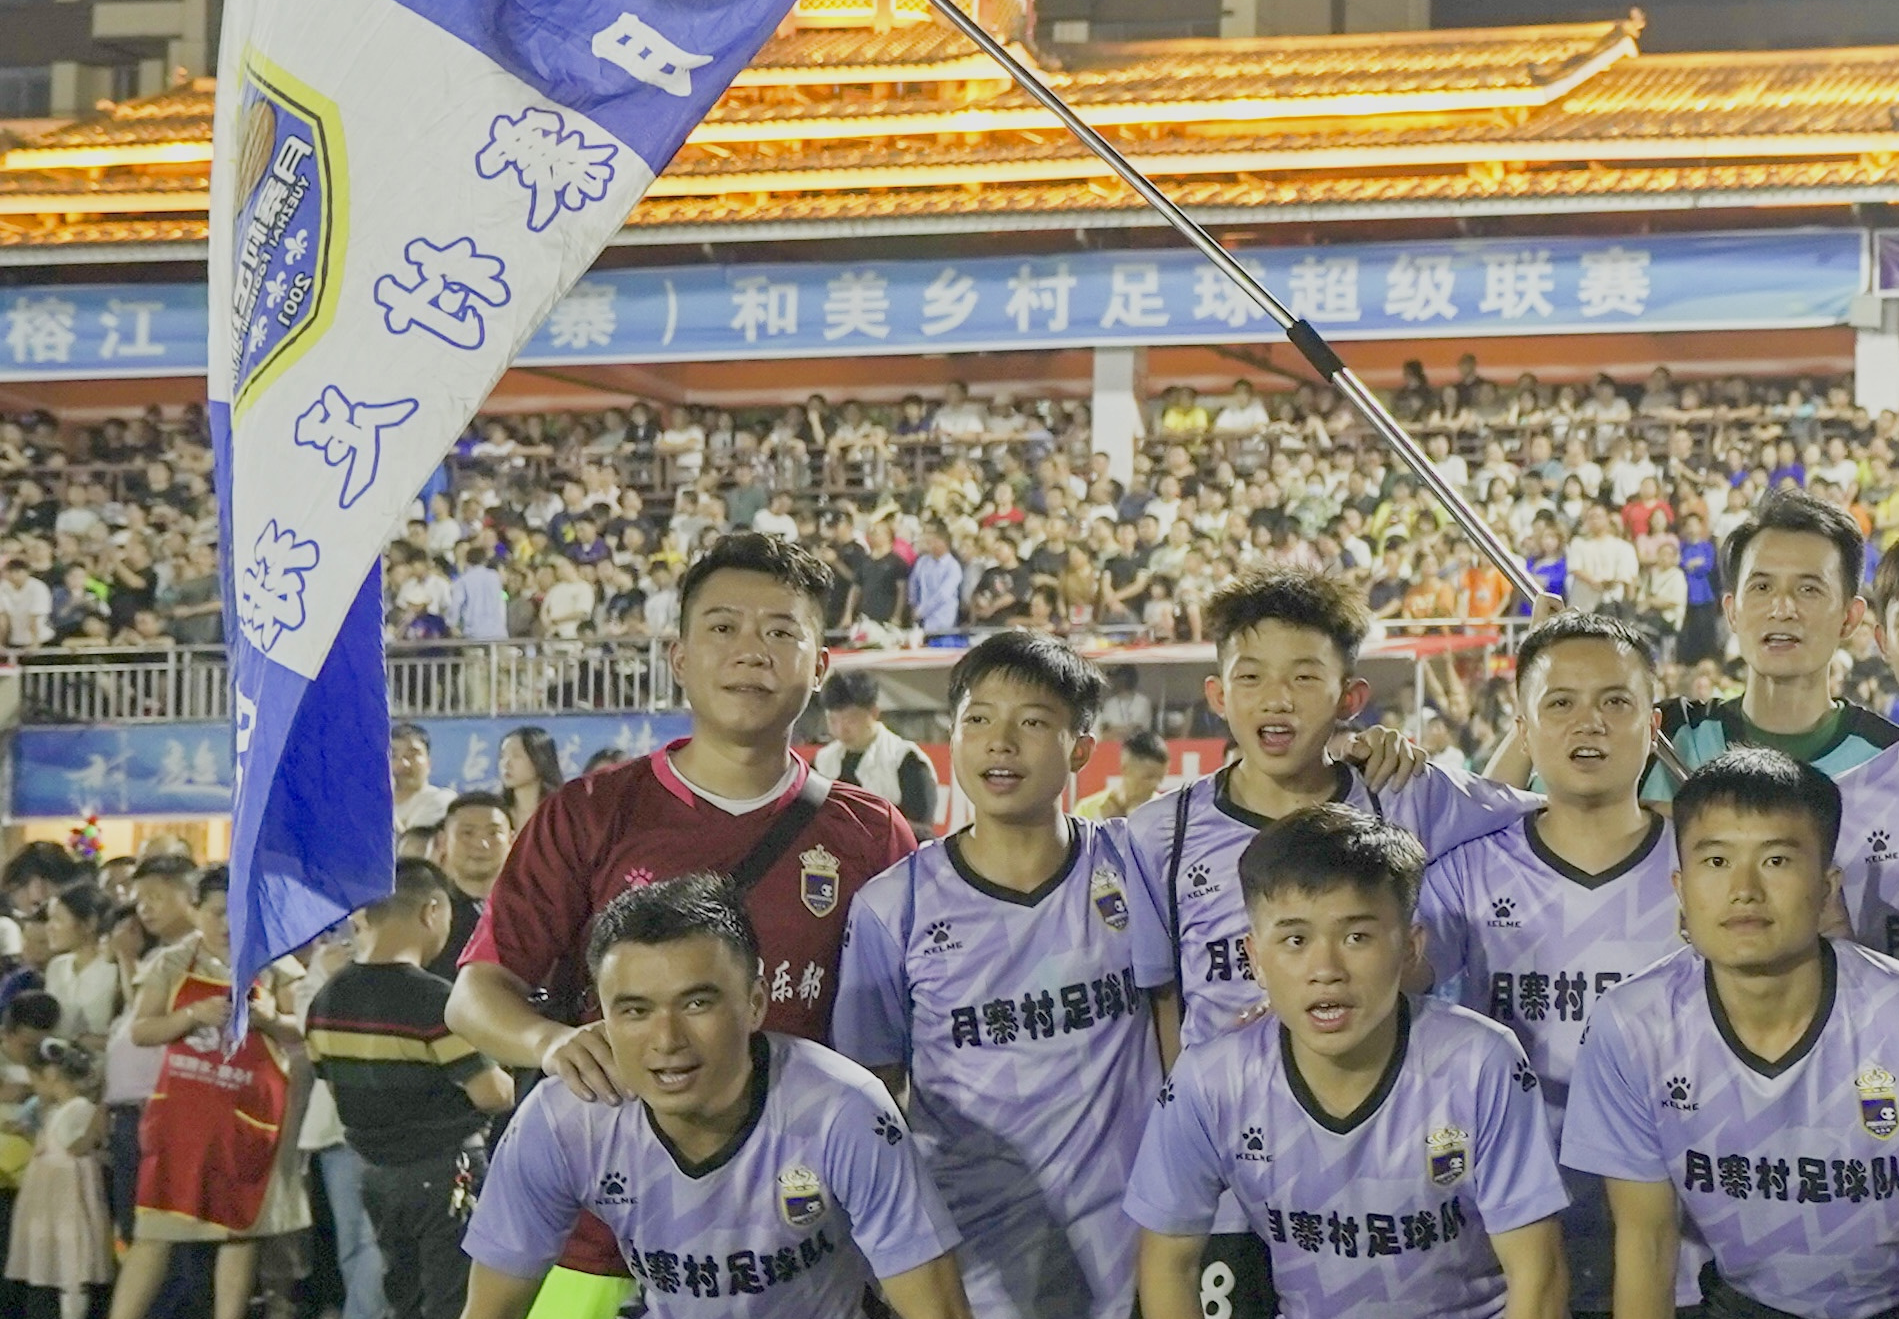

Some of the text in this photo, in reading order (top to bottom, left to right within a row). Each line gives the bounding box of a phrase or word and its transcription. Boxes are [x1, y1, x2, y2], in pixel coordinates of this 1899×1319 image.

[5, 296, 167, 363] 榕江
[1864, 852, 1899, 863] KELME
[1187, 885, 1221, 900] KELME
[923, 941, 964, 956] KELME
[764, 961, 824, 1009] 乐部
[1661, 1100, 1699, 1111] KELME
[1236, 1153, 1273, 1162] KELME
